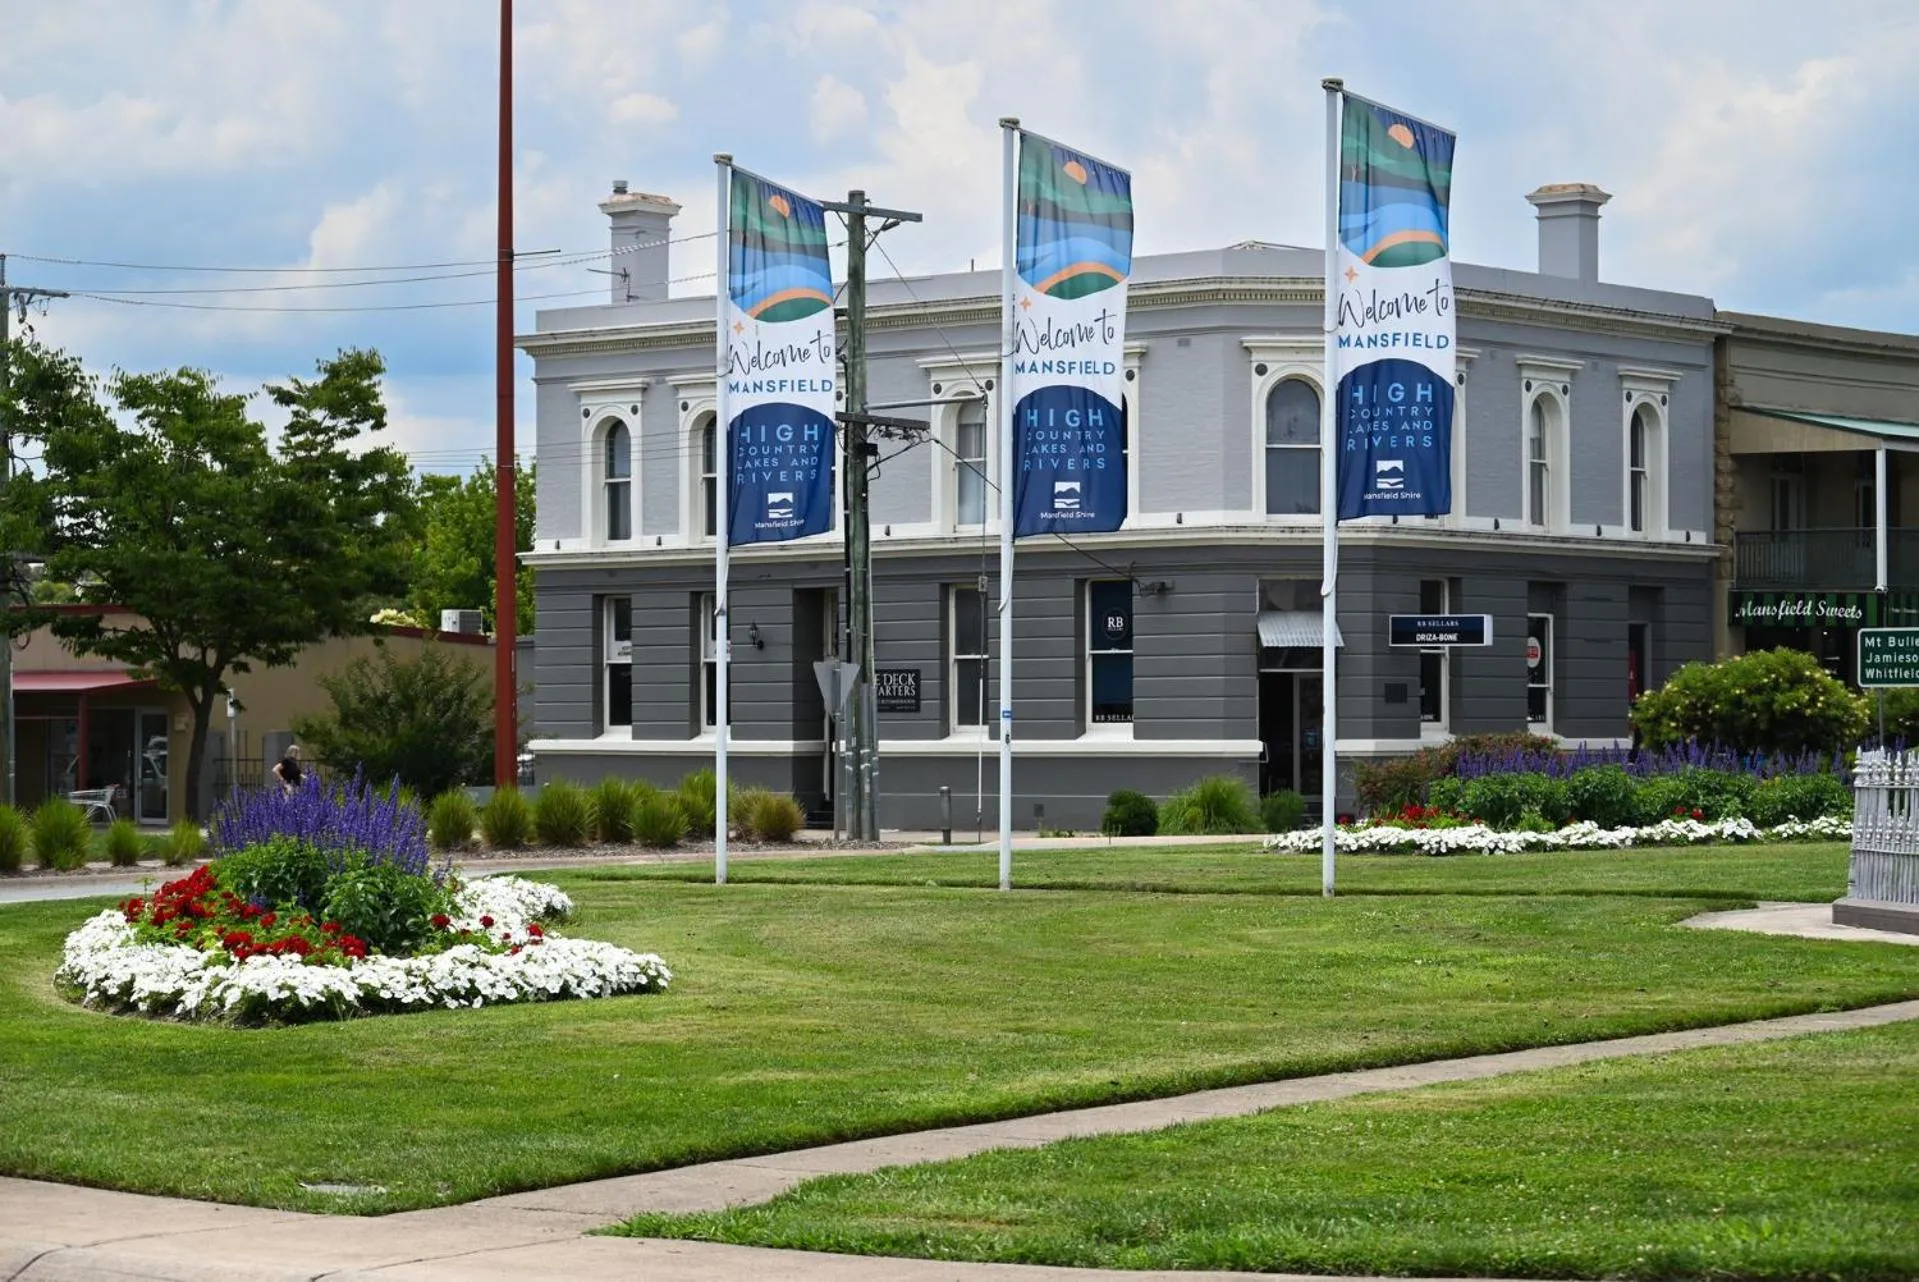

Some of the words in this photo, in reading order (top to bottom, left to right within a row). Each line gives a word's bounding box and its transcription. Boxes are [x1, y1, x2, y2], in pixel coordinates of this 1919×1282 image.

[1326, 289, 1427, 333] Welcome
[1426, 278, 1449, 316] to
[1004, 316, 1095, 357] Welcome
[1094, 308, 1117, 345] to
[1338, 333, 1449, 349] MANSFIELD
[717, 339, 811, 377] Welcome
[809, 329, 833, 364] to
[1015, 360, 1116, 375] MANSFIELD
[728, 379, 833, 394] MANSFIELD
[1352, 383, 1433, 405] HIGH
[1026, 408, 1104, 428] HIGH
[740, 423, 819, 443] HIGH
[1349, 420, 1390, 434] AKES
[1401, 420, 1433, 431] AND
[1027, 430, 1105, 441] OUNTRY
[1025, 444, 1067, 456] AKES
[1079, 443, 1105, 453] AND
[1347, 436, 1432, 451] RIVERS
[737, 458, 779, 471] AKES
[790, 456, 818, 468] AND
[1024, 457, 1105, 471] RIVERS
[737, 469, 817, 485] RIVERS
[1735, 599, 1812, 620] Mansfield
[1815, 600, 1863, 619] Sweets
[1107, 616, 1124, 628] RB
[1864, 636, 1882, 648] Mt
[1865, 652, 1919, 664] Jamieso
[883, 673, 916, 687] DECK
[876, 685, 916, 697] ARTERS
